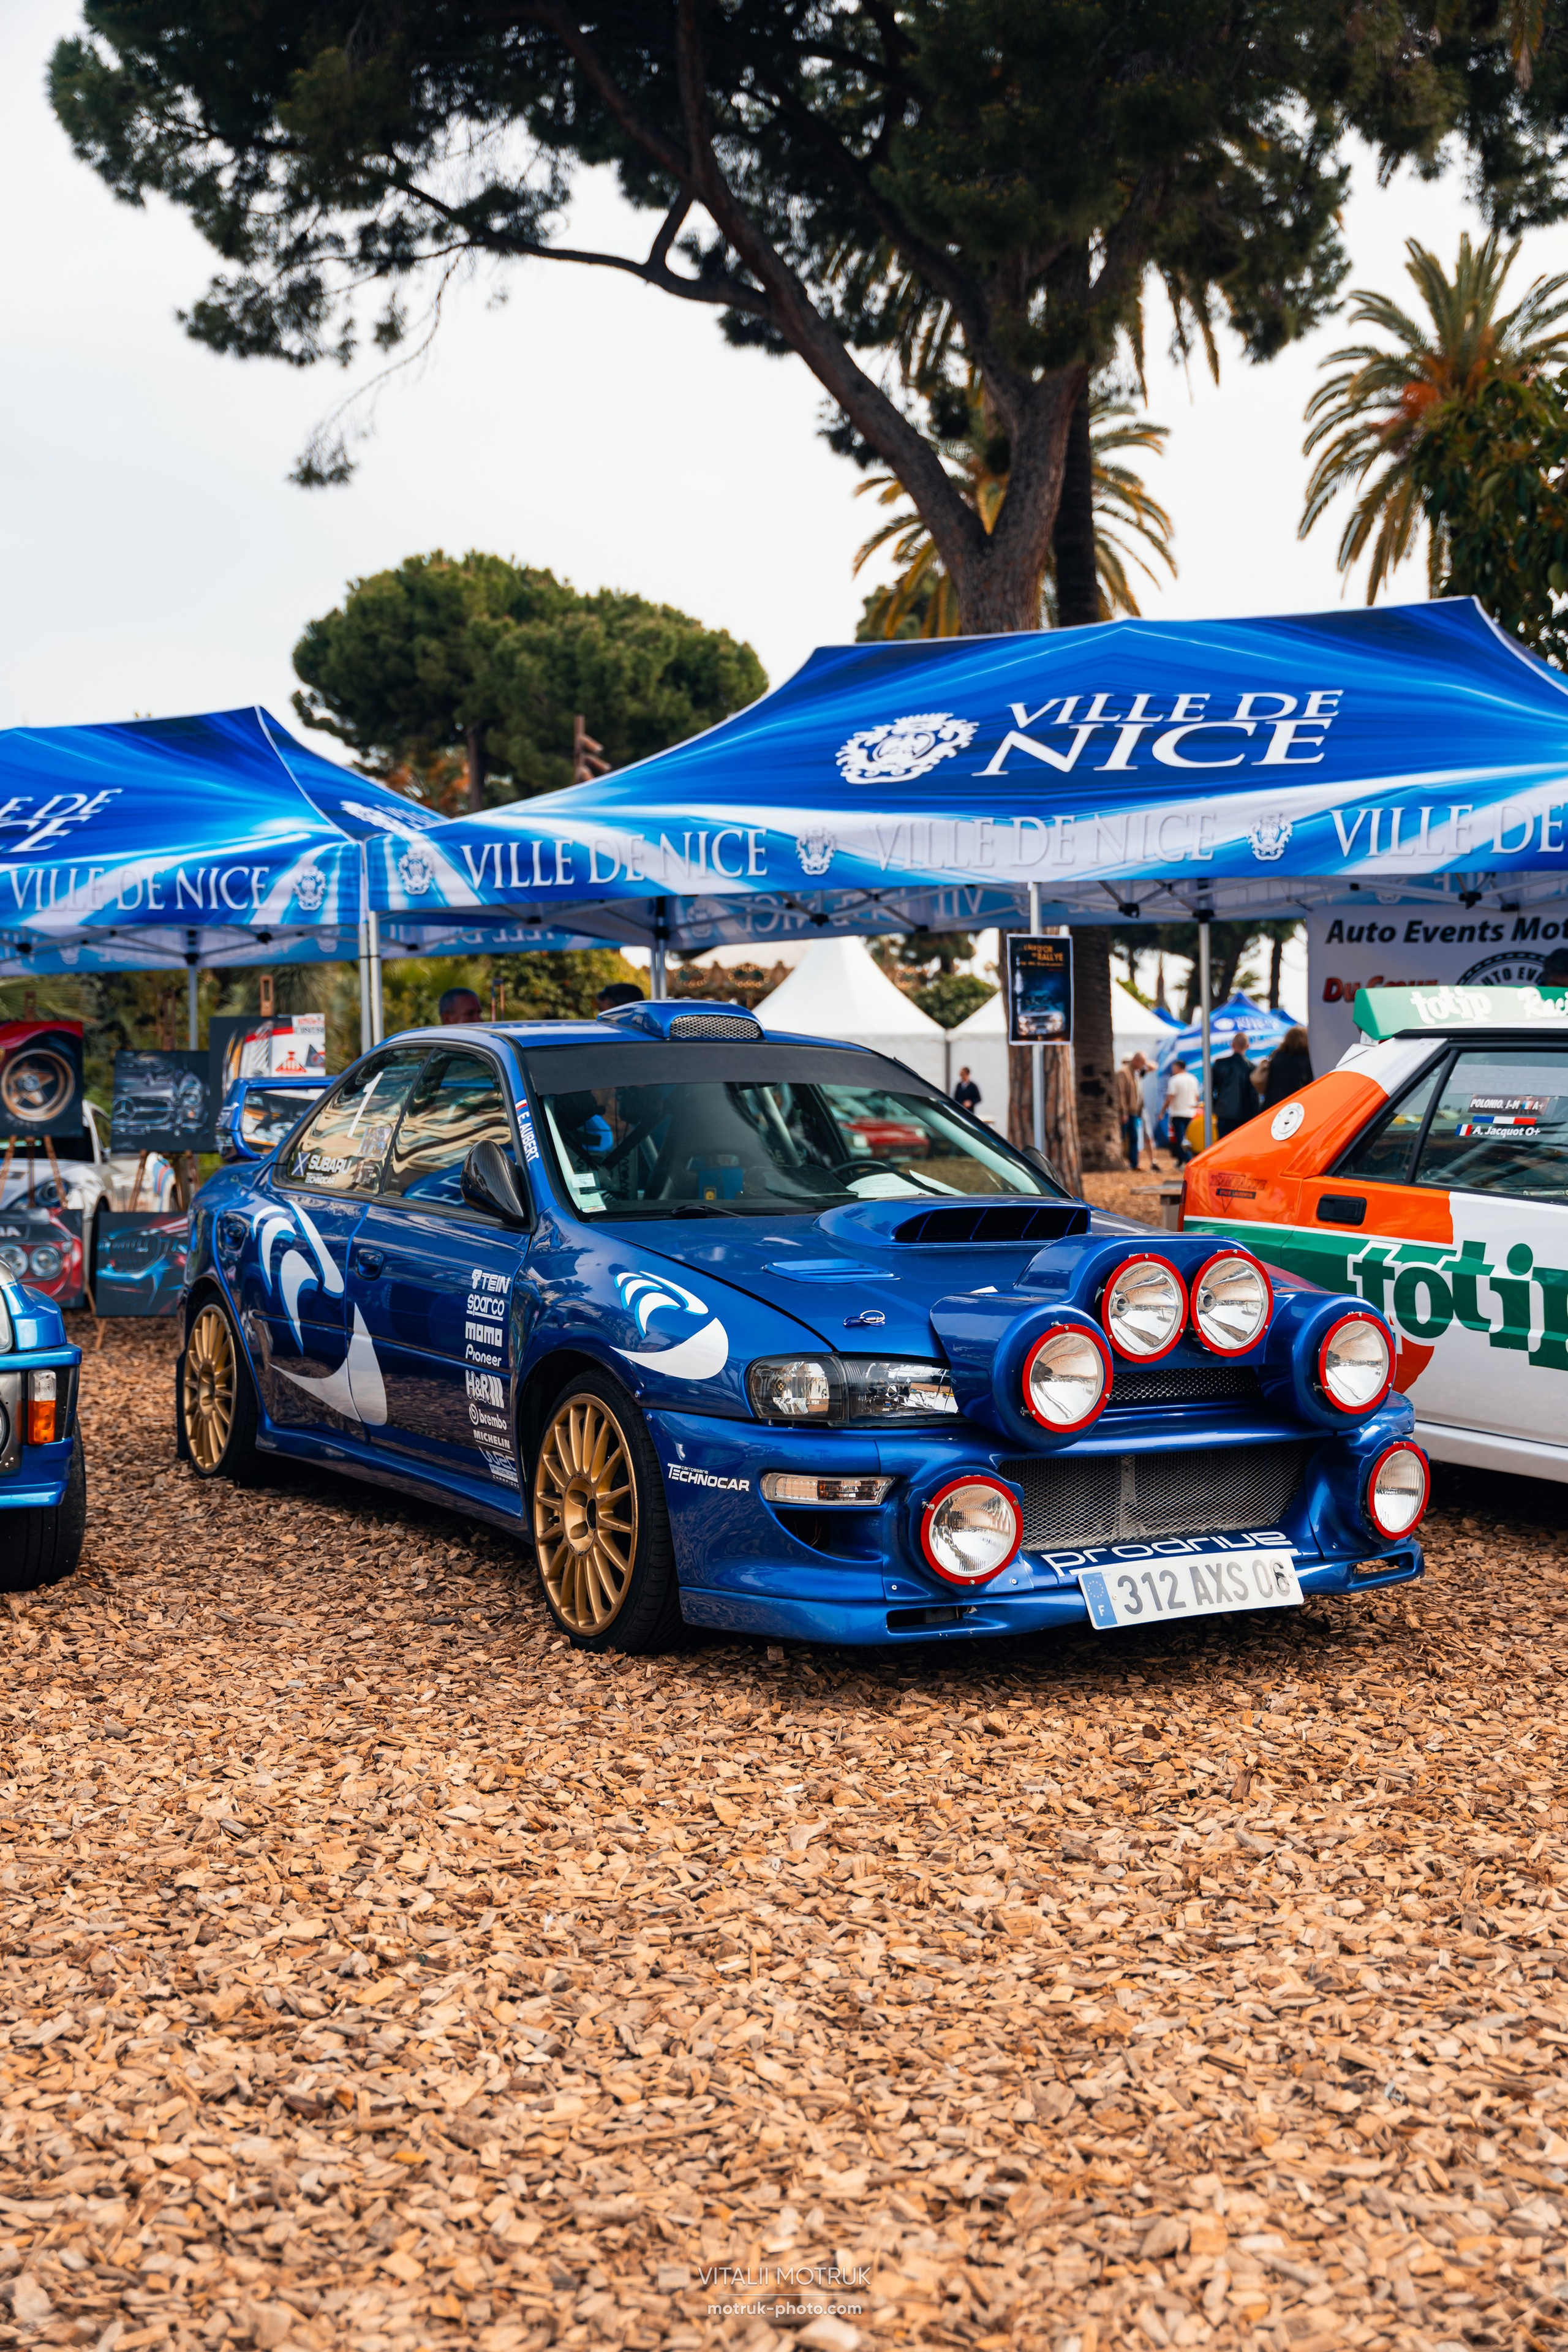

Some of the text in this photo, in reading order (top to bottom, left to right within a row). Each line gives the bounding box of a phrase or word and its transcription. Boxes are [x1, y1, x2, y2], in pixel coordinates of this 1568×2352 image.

[1006, 689, 1344, 728] VILLE DE
[971, 718, 1333, 777] NICE
[32, 788, 123, 820] DE
[869, 812, 1217, 872] VILLE DE NICE
[1329, 802, 1566, 858] VILLE DE
[459, 828, 769, 891] VILLE DE NICE
[9, 866, 270, 911] VILLE DE NICE
[1325, 920, 1396, 944] Auto
[1403, 920, 1505, 944] Events
[1410, 986, 1492, 1025] totip
[1532, 1101, 1545, 1110] A+
[517, 1111, 540, 1163] E. AUBERT
[1484, 1126, 1524, 1139] Jacquot
[1525, 1127, 1541, 1137] O+
[308, 1154, 352, 1175] SUBARU
[481, 1272, 511, 1294] TEIN
[467, 1294, 505, 1317] sparco
[466, 1344, 502, 1367] Pioneer
[466, 1370, 492, 1404] H&R
[478, 1409, 507, 1431] brembo
[473, 1429, 511, 1450] MICHELIN
[667, 1463, 750, 1492] TECHNOCAR
[1041, 1531, 1294, 1578] prodrive
[1117, 1558, 1291, 1615] 312 AXS 06
[1098, 1604, 1105, 1617] F
